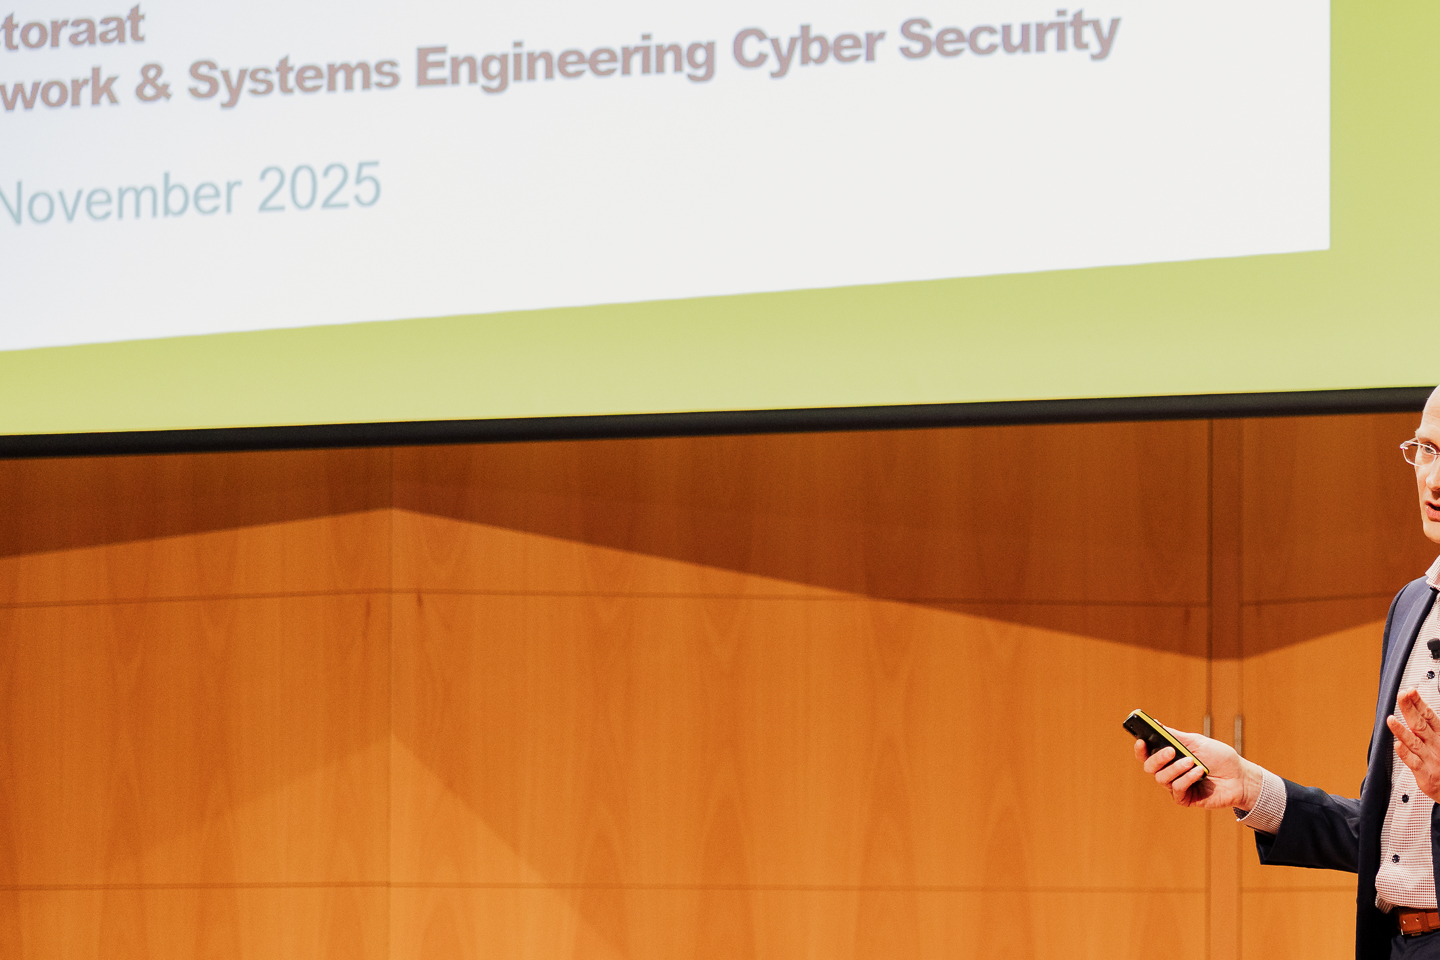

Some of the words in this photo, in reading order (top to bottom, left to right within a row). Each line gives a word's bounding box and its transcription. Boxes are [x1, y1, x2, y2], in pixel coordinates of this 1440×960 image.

[0, 4, 145, 51] toraat
[0, 66, 119, 111] work
[135, 62, 172, 103] &
[188, 55, 401, 109] Systems
[416, 39, 716, 94] Engineering
[733, 24, 886, 79] Cyber
[899, 9, 1121, 61] Security
[0, 171, 242, 226] November
[258, 161, 382, 213] 2025
